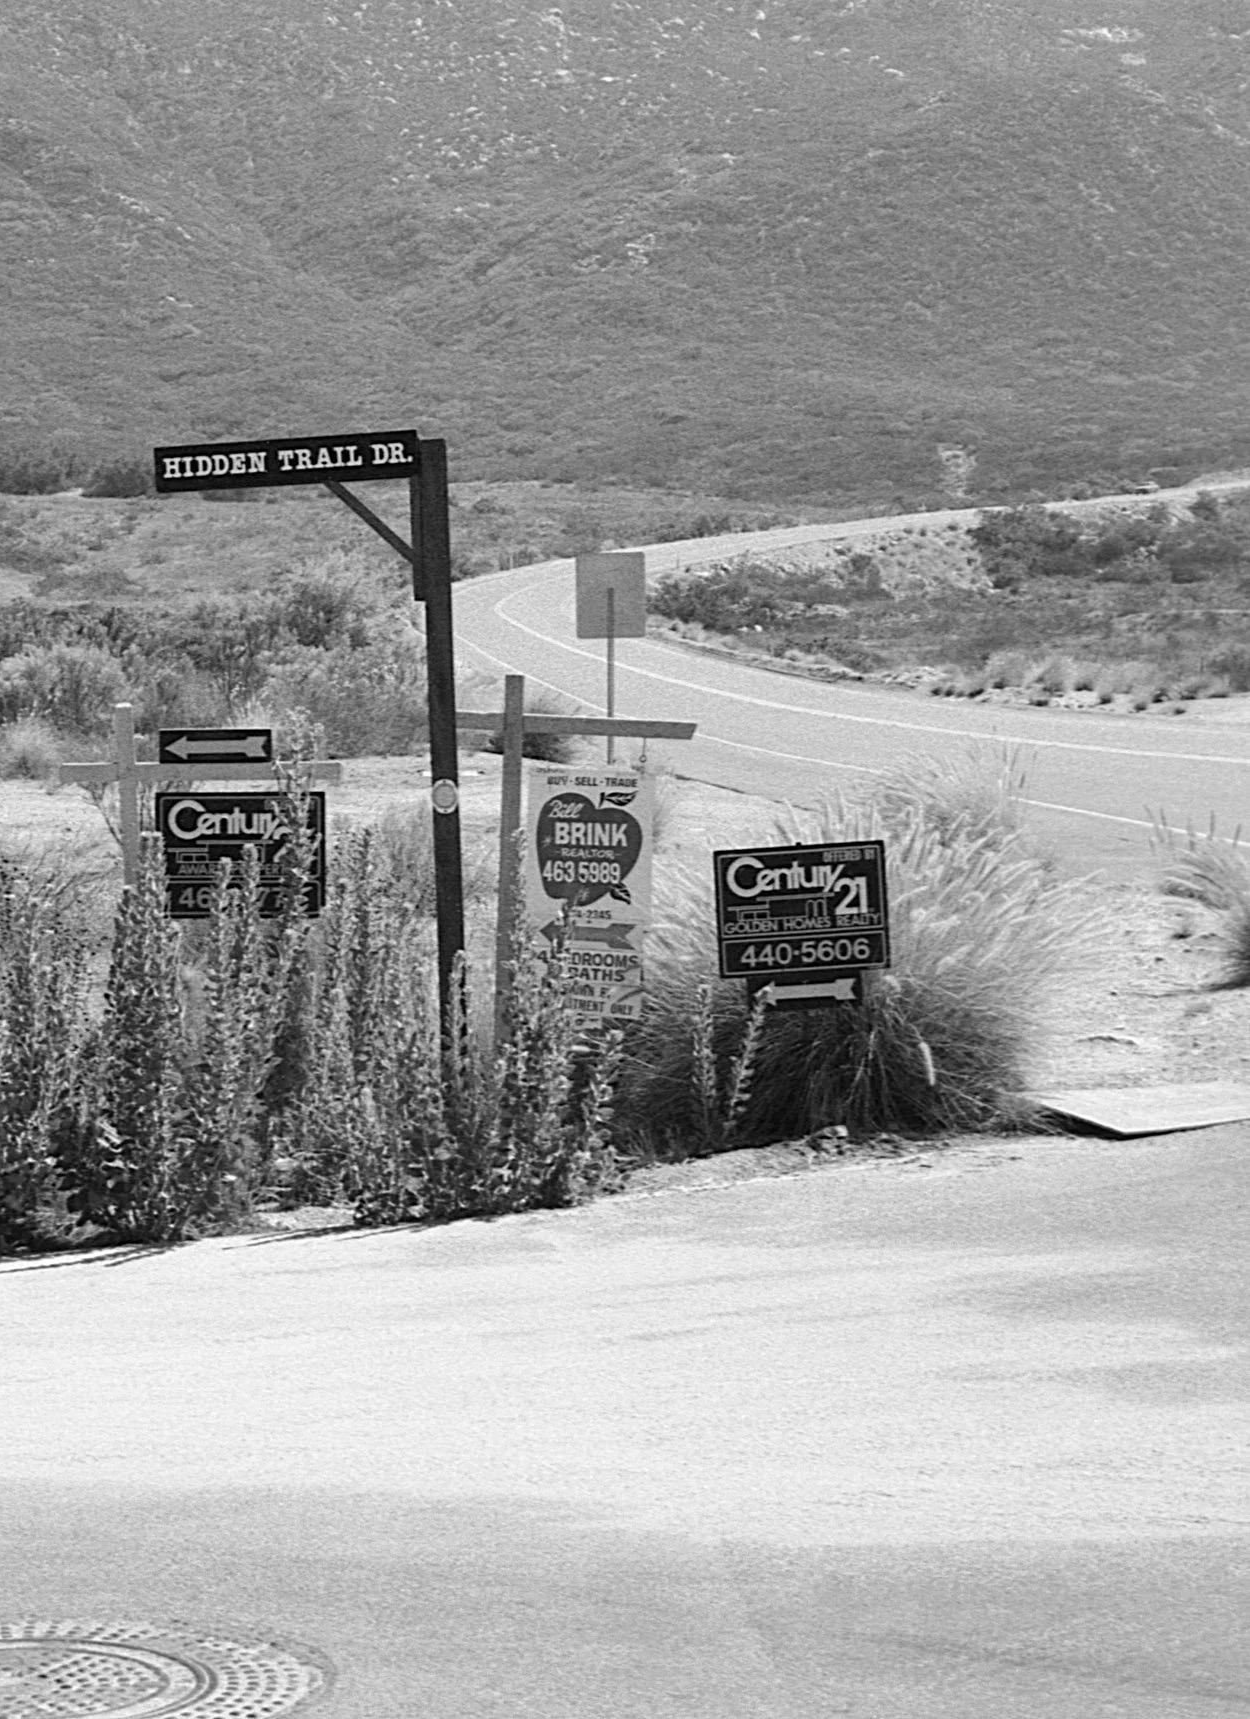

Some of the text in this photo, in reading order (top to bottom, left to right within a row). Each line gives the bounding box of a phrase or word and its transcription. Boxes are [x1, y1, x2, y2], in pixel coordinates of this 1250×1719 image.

[162, 442, 414, 478] HIDDEN TRAIL DR.
[574, 776, 598, 786] SELL
[605, 777, 638, 787] TRADE
[168, 799, 282, 840] Century
[548, 799, 586, 818] Bill
[554, 822, 628, 847] BRINK
[542, 860, 621, 884] 463 5989
[726, 856, 869, 915] Century 21
[725, 913, 881, 934] GOLDEN HOMES REALTY
[741, 938, 871, 967] 440-5606
